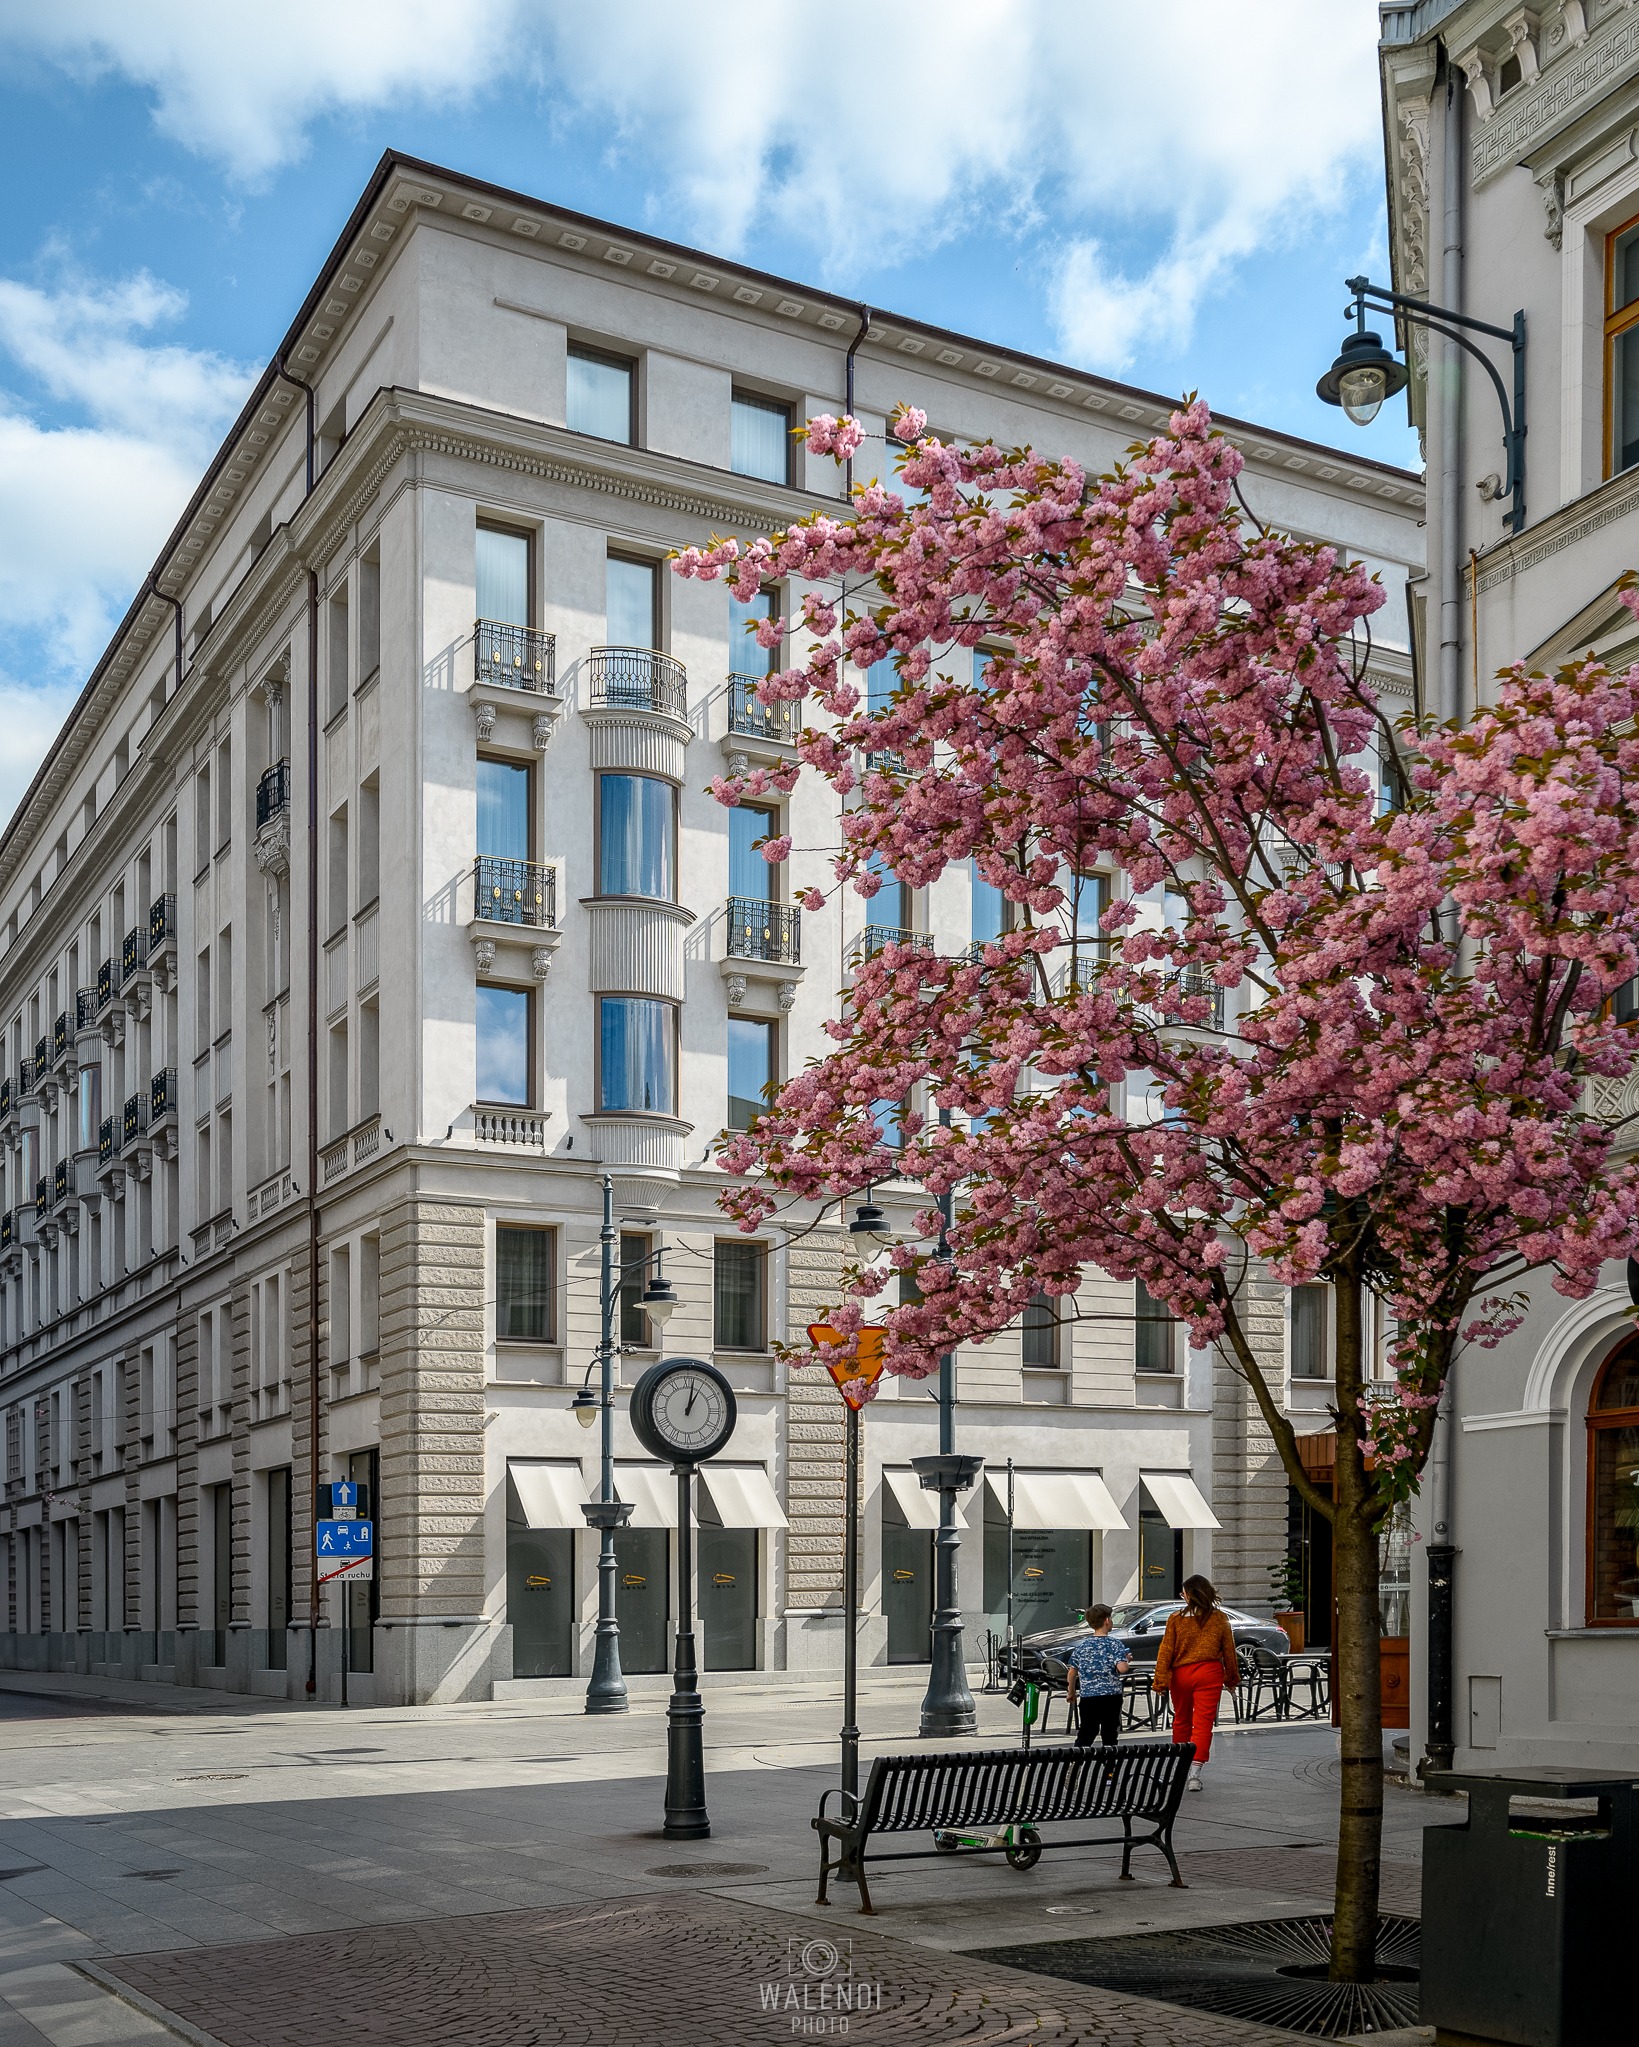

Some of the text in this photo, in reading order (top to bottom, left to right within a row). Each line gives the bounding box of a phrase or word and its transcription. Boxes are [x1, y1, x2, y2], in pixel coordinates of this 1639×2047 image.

[320, 1571, 371, 1579] Stfa ruchu
[1545, 1845, 1557, 1897] inne/rest
